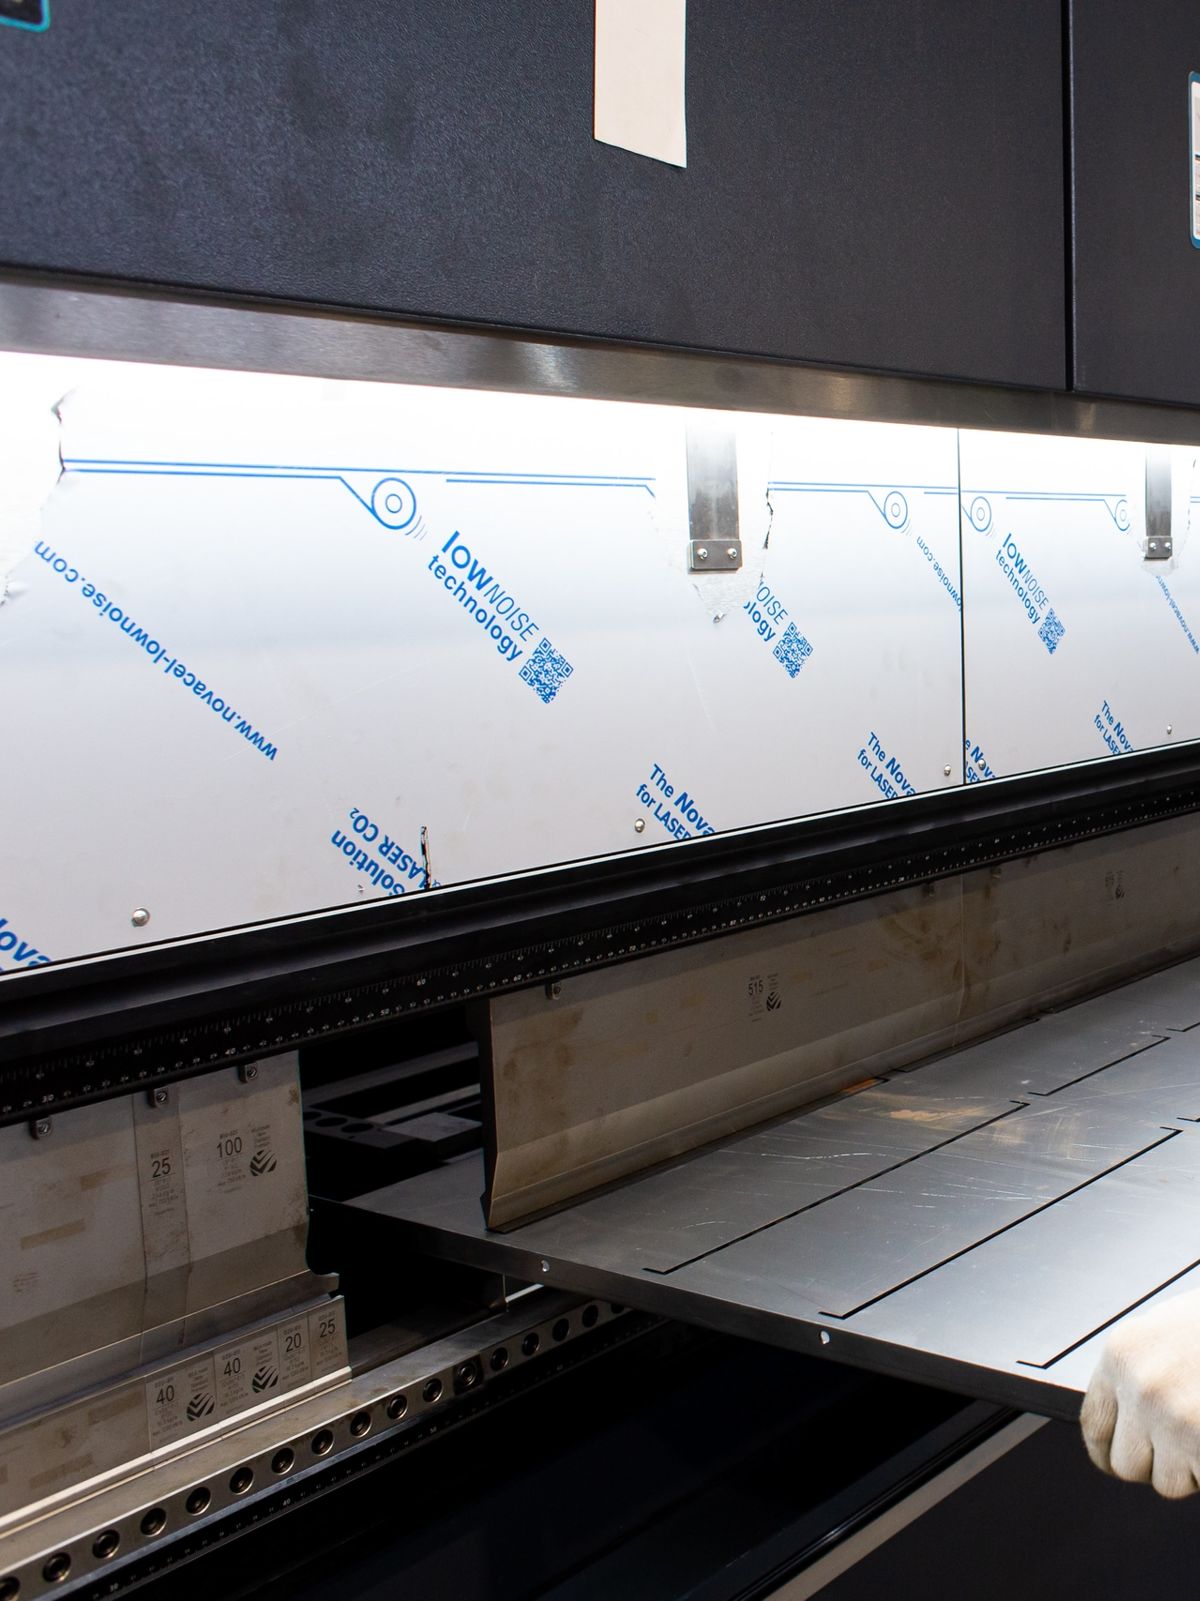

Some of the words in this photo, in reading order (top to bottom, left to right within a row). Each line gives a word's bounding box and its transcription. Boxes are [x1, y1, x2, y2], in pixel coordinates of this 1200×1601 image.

[441, 530, 540, 642] lowNOISE
[916, 536, 962, 612] ownoise.com
[996, 549, 1041, 624] technology
[428, 554, 523, 662] technology
[756, 582, 788, 625] OISE
[33, 540, 278, 761] www.novacel-lownoise.com
[1094, 714, 1104, 731] for
[1102, 700, 1114, 725] The
[867, 732, 886, 762] The
[857, 749, 872, 770] for
[650, 763, 674, 798] The
[636, 784, 656, 808] for
[748, 980, 764, 996] 515
[216, 1136, 243, 1158] 100
[152, 1157, 171, 1178] 25
[320, 1319, 336, 1338] 25
[285, 1332, 302, 1353] 20
[223, 1357, 241, 1376] 40
[156, 1384, 175, 1404] 40
